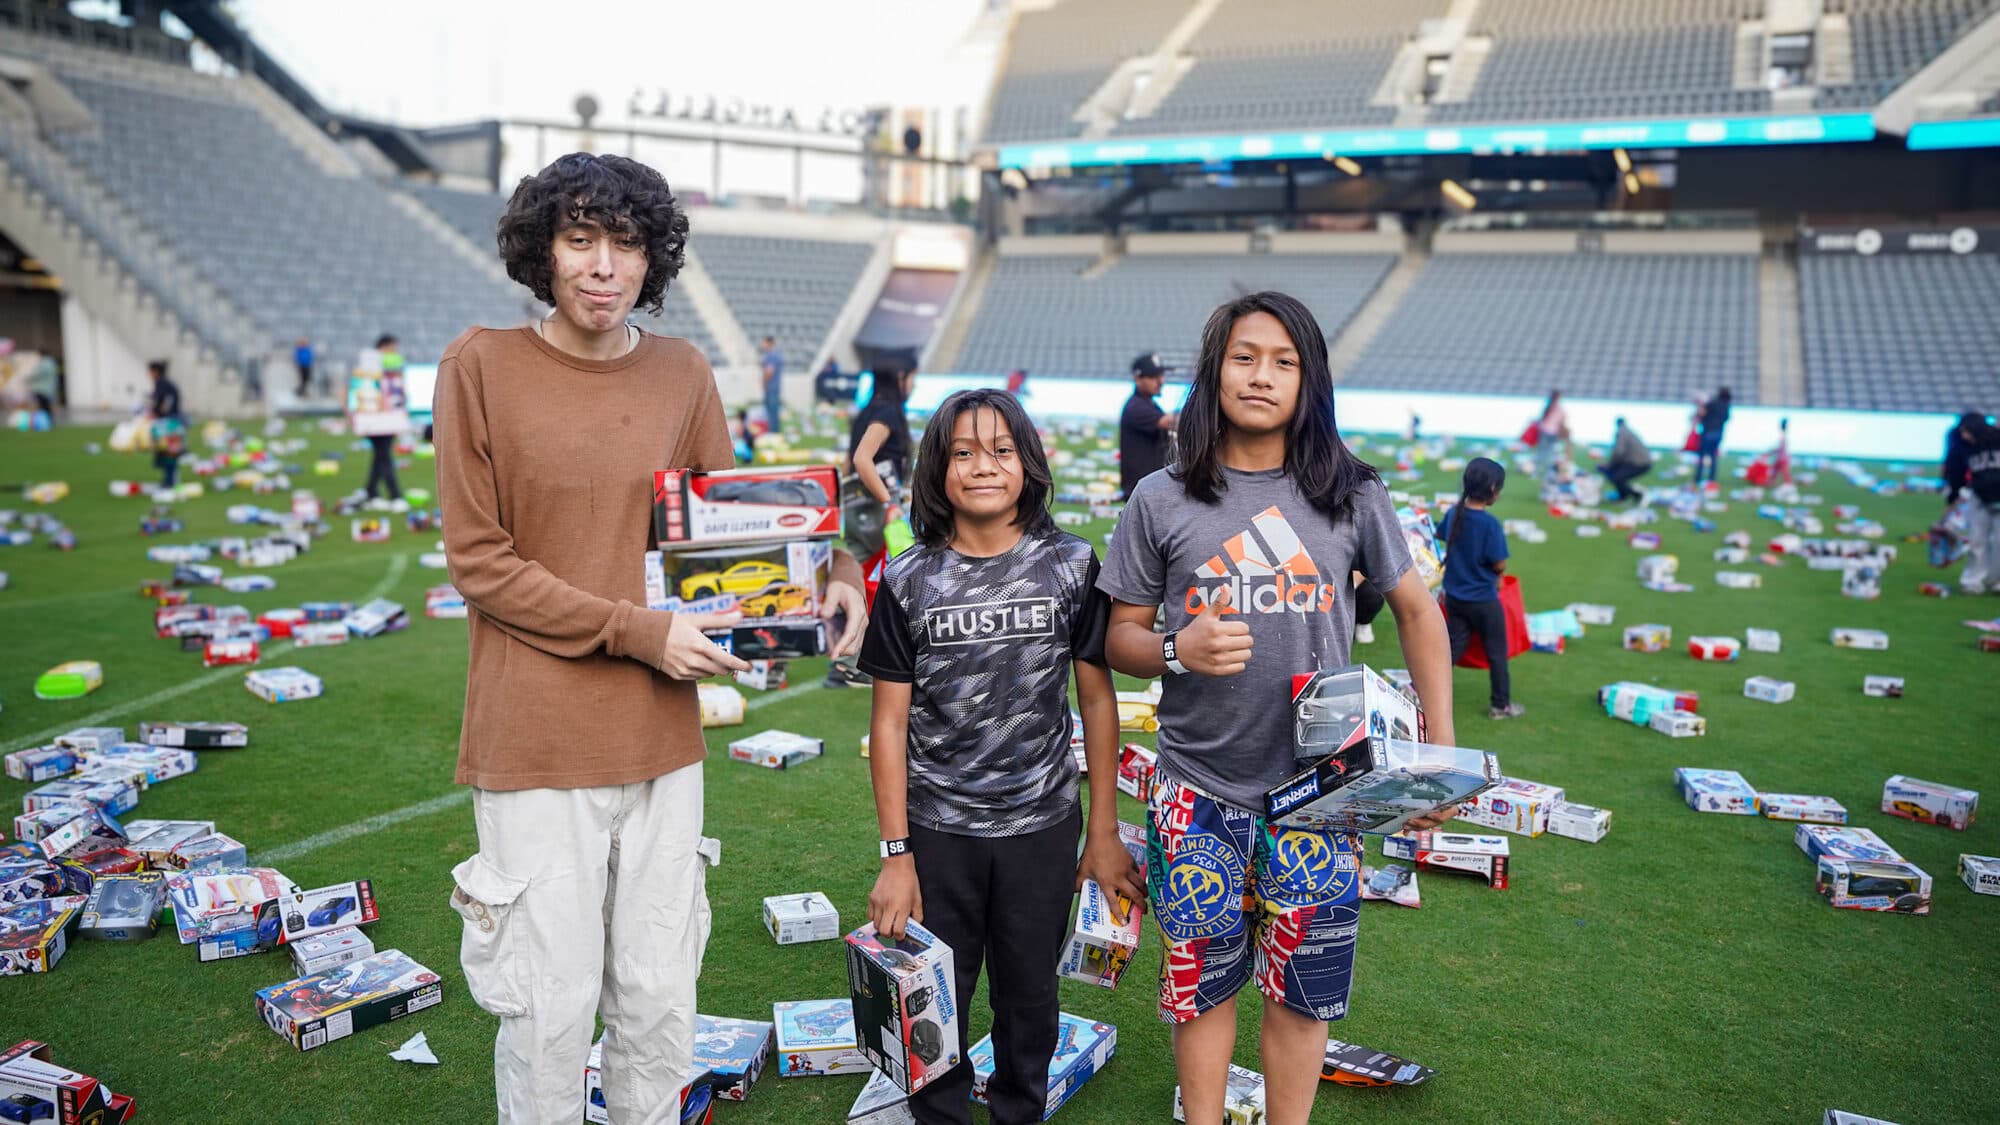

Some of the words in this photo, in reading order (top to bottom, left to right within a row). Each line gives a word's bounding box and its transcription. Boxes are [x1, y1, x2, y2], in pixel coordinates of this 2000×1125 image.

[1185, 574, 1336, 615] adidas
[936, 605, 1048, 638] HUSTLE
[1164, 641, 1174, 659] SB
[1273, 779, 1318, 812] HORNET
[889, 841, 905, 854] SB
[1192, 854, 1217, 870] 1936
[1090, 882, 1098, 923] MUSTANG
[1082, 907, 1092, 932] FORD
[1172, 913, 1235, 937] ATLANTIC
[932, 962, 955, 1018] LAMBORGHINI
